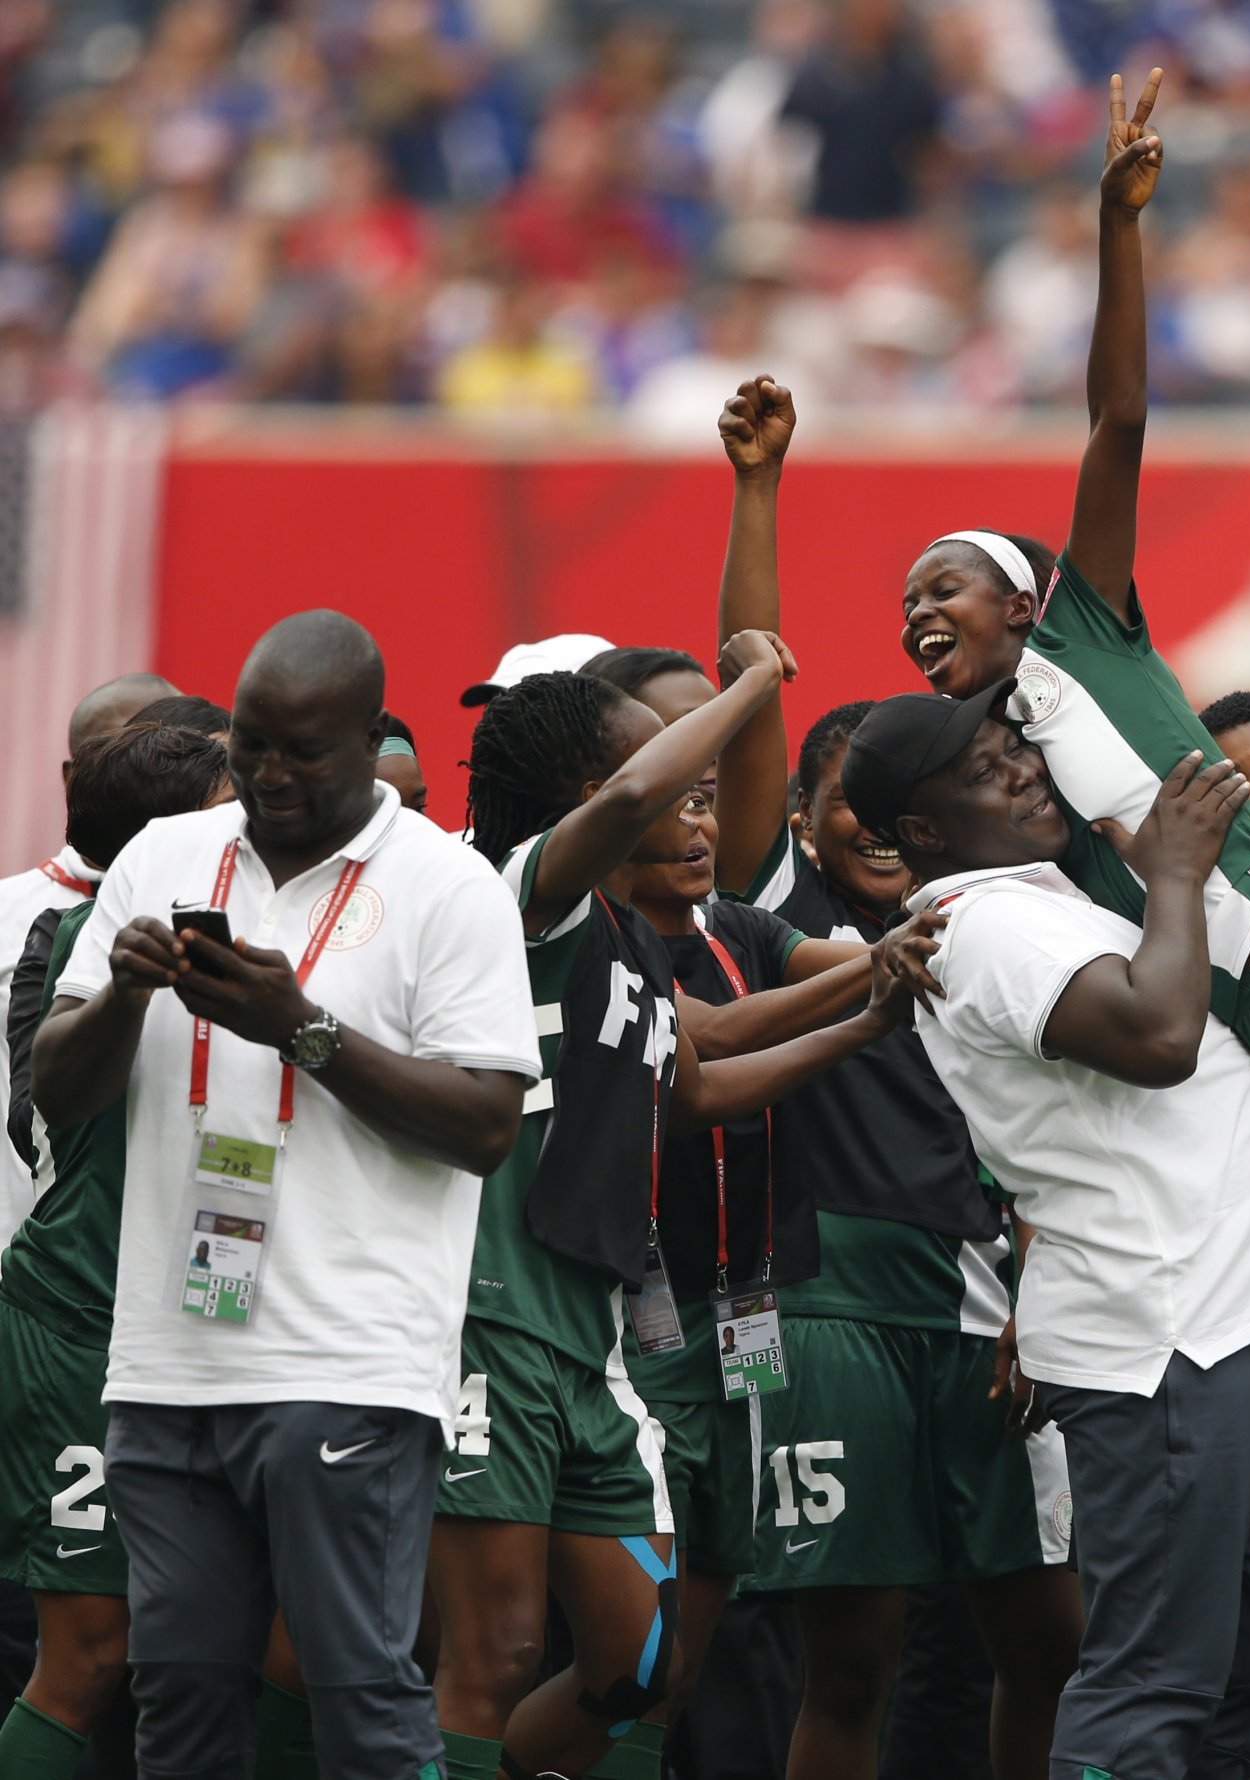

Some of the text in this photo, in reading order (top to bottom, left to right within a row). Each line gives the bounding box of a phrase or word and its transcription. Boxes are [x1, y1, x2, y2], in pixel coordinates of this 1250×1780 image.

[1022, 666, 1058, 689] FEDERATION
[477, 1278, 504, 1289] DRI-FIT
[745, 1350, 778, 1365] 1 2 3
[773, 1363, 779, 1372] 6
[748, 1382, 755, 1391] 7
[769, 1440, 846, 1527] 15
